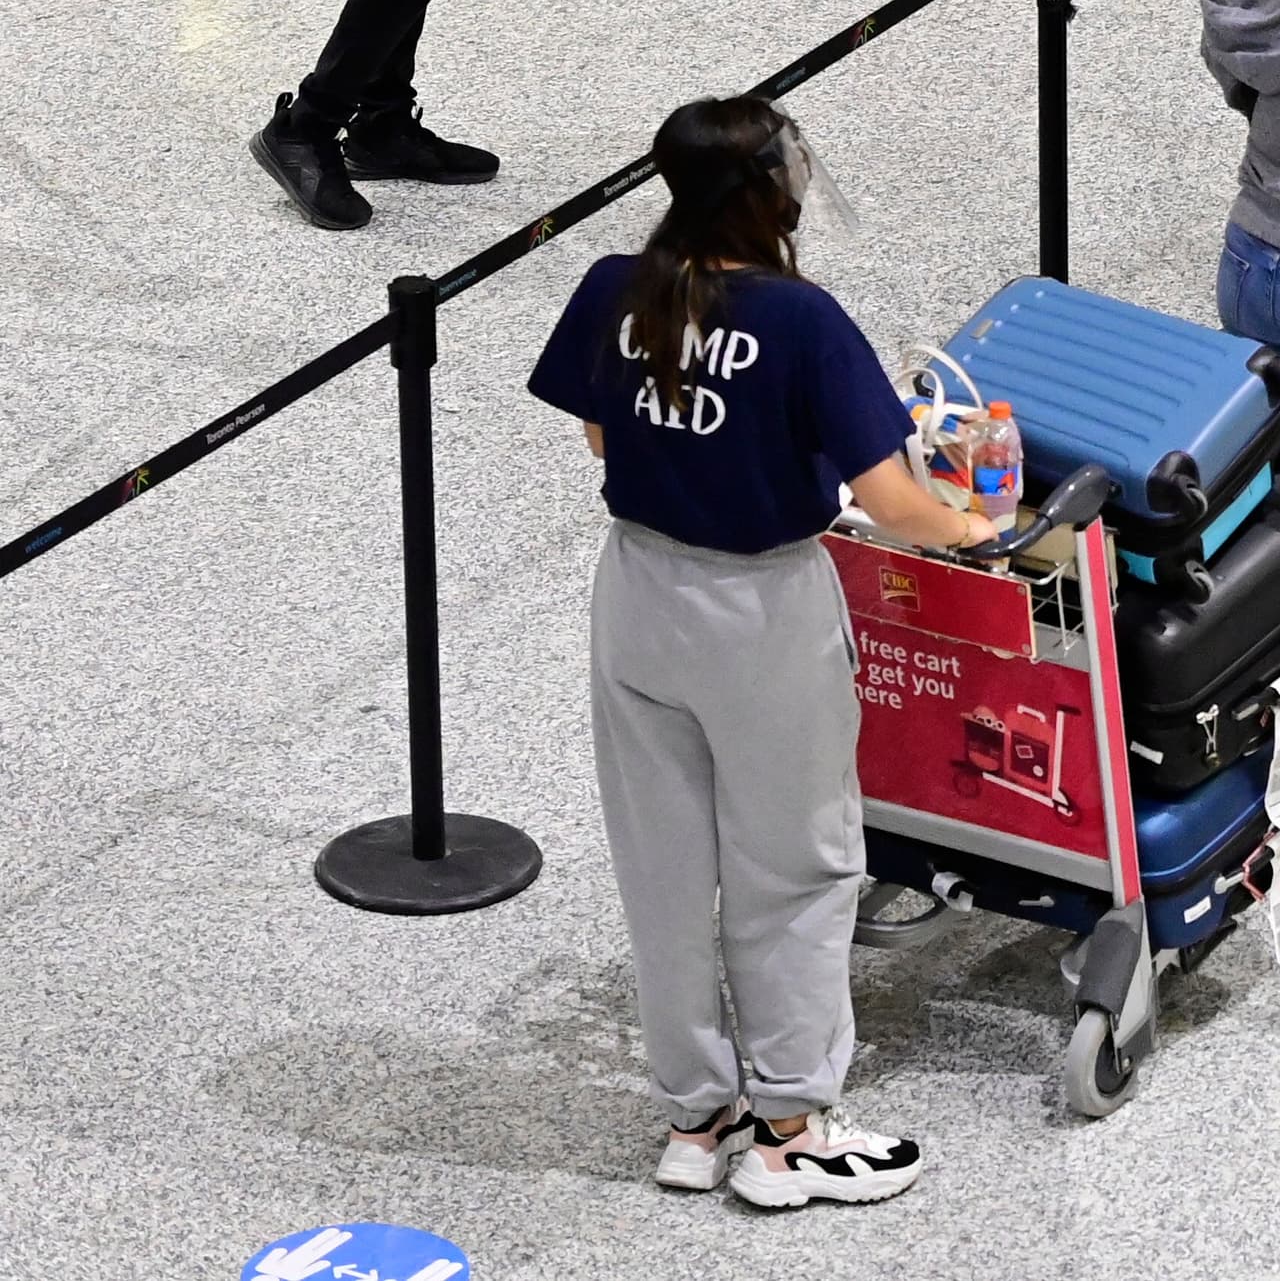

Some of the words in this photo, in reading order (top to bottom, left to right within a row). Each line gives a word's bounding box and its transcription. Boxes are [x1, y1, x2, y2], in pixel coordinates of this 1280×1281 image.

[603, 176, 629, 198] Toronto
[619, 312, 759, 380] CMP
[205, 422, 235, 445] Toronto
[235, 403, 265, 428] Pearson
[25, 526, 62, 554] welcome
[883, 572, 914, 591] CIBC
[859, 631, 907, 663] free
[913, 651, 961, 678] cart
[854, 682, 902, 709] here
[867, 663, 906, 687] get
[911, 674, 954, 699] you
